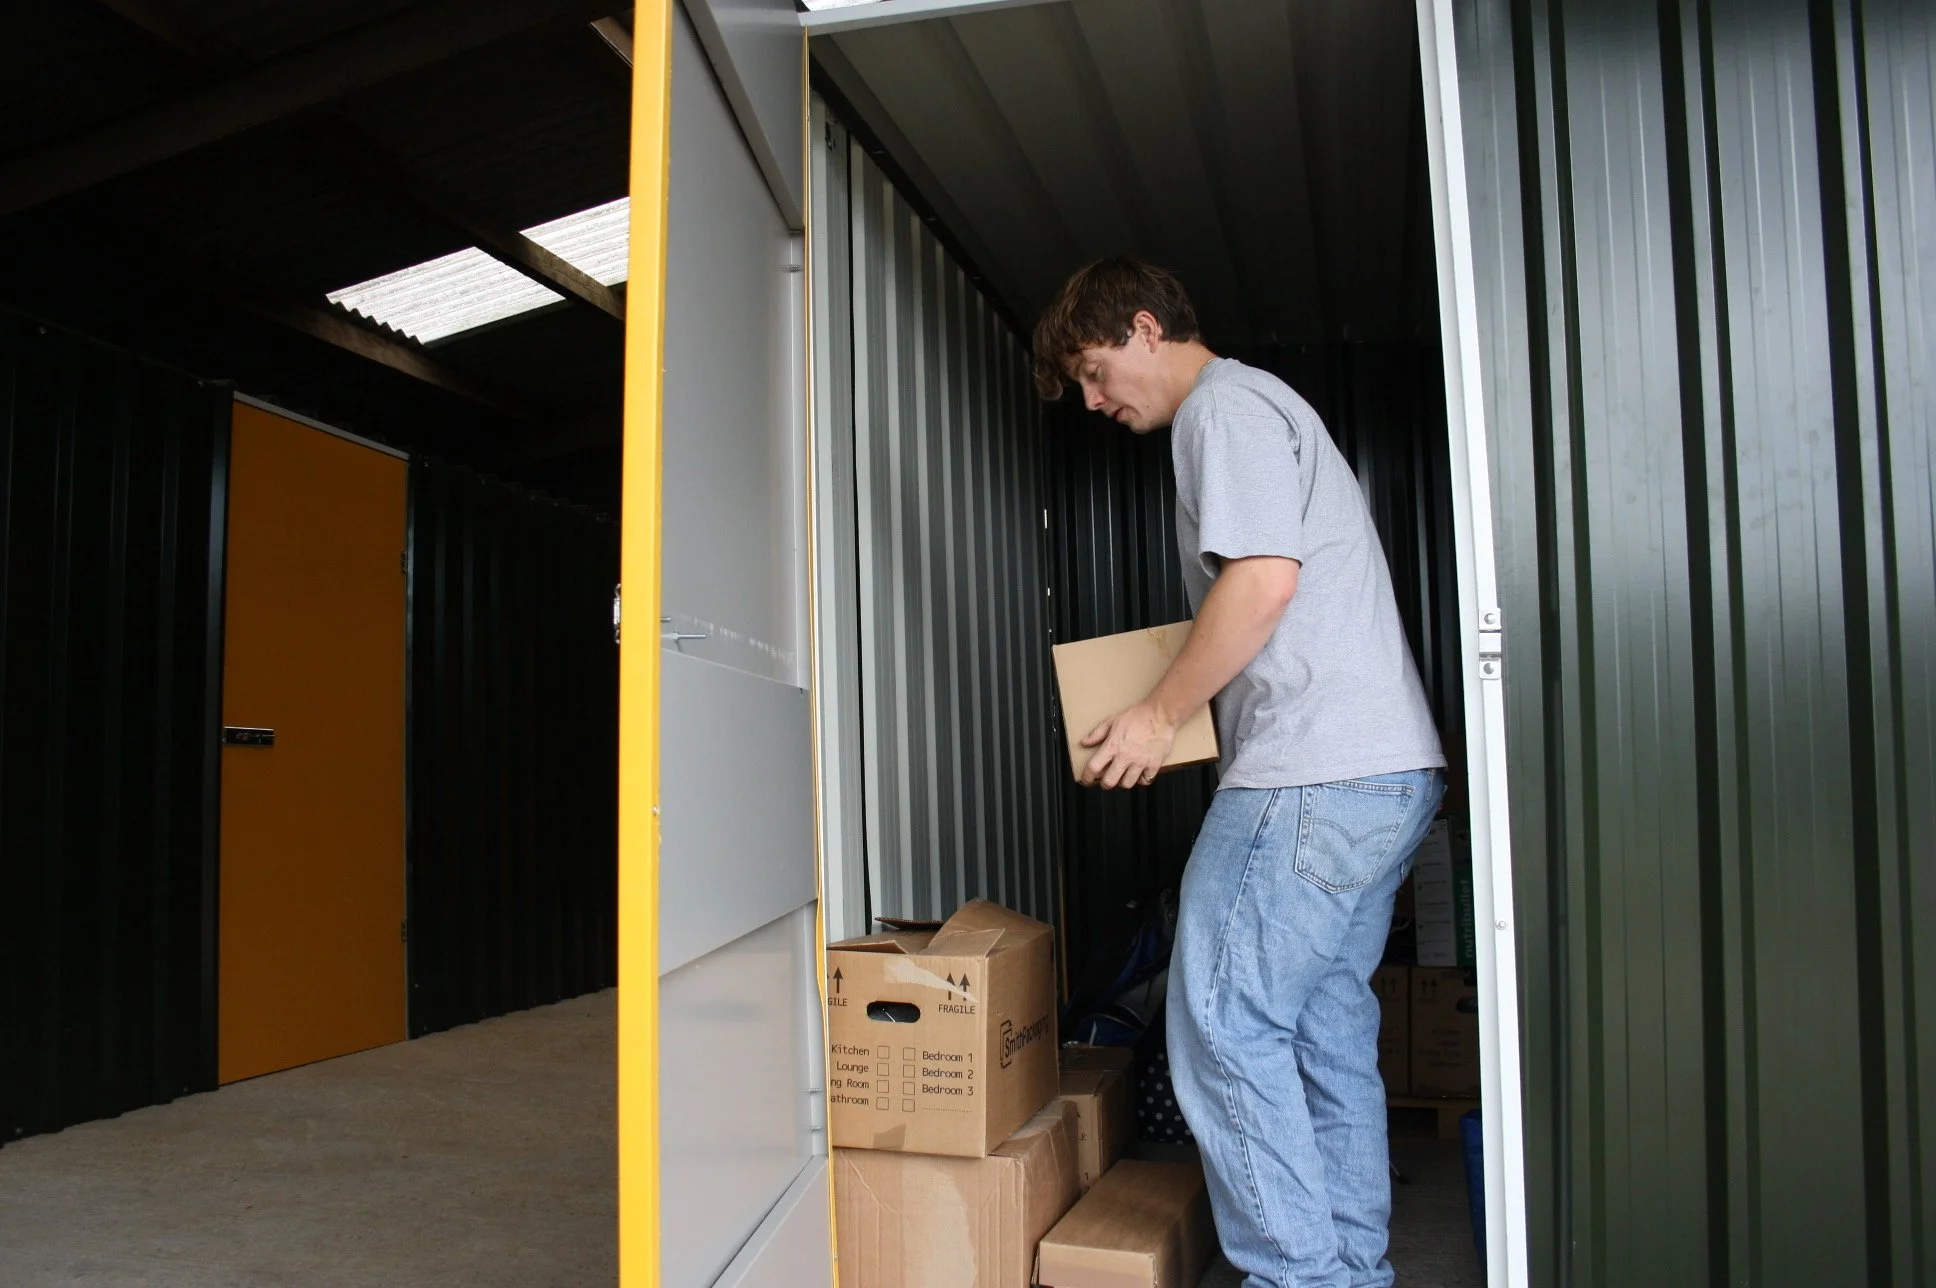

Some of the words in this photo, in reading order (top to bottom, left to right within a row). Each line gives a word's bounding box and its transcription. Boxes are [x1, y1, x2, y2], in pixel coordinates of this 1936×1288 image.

[1460, 879, 1473, 959] nutribullet
[828, 997, 847, 1007] GILE
[938, 1004, 976, 1015] FRAGILE
[831, 1044, 870, 1056] Kitchen
[922, 1050, 963, 1062] Bedroom
[968, 1053, 973, 1063] 1
[836, 1061, 869, 1073] Lounge
[922, 1067, 963, 1079] Bedroom
[967, 1069, 974, 1080] 2
[846, 1078, 870, 1089] Room
[922, 1084, 963, 1096] Bedroom
[967, 1086, 974, 1096] 3
[830, 1094, 869, 1106] athroom
